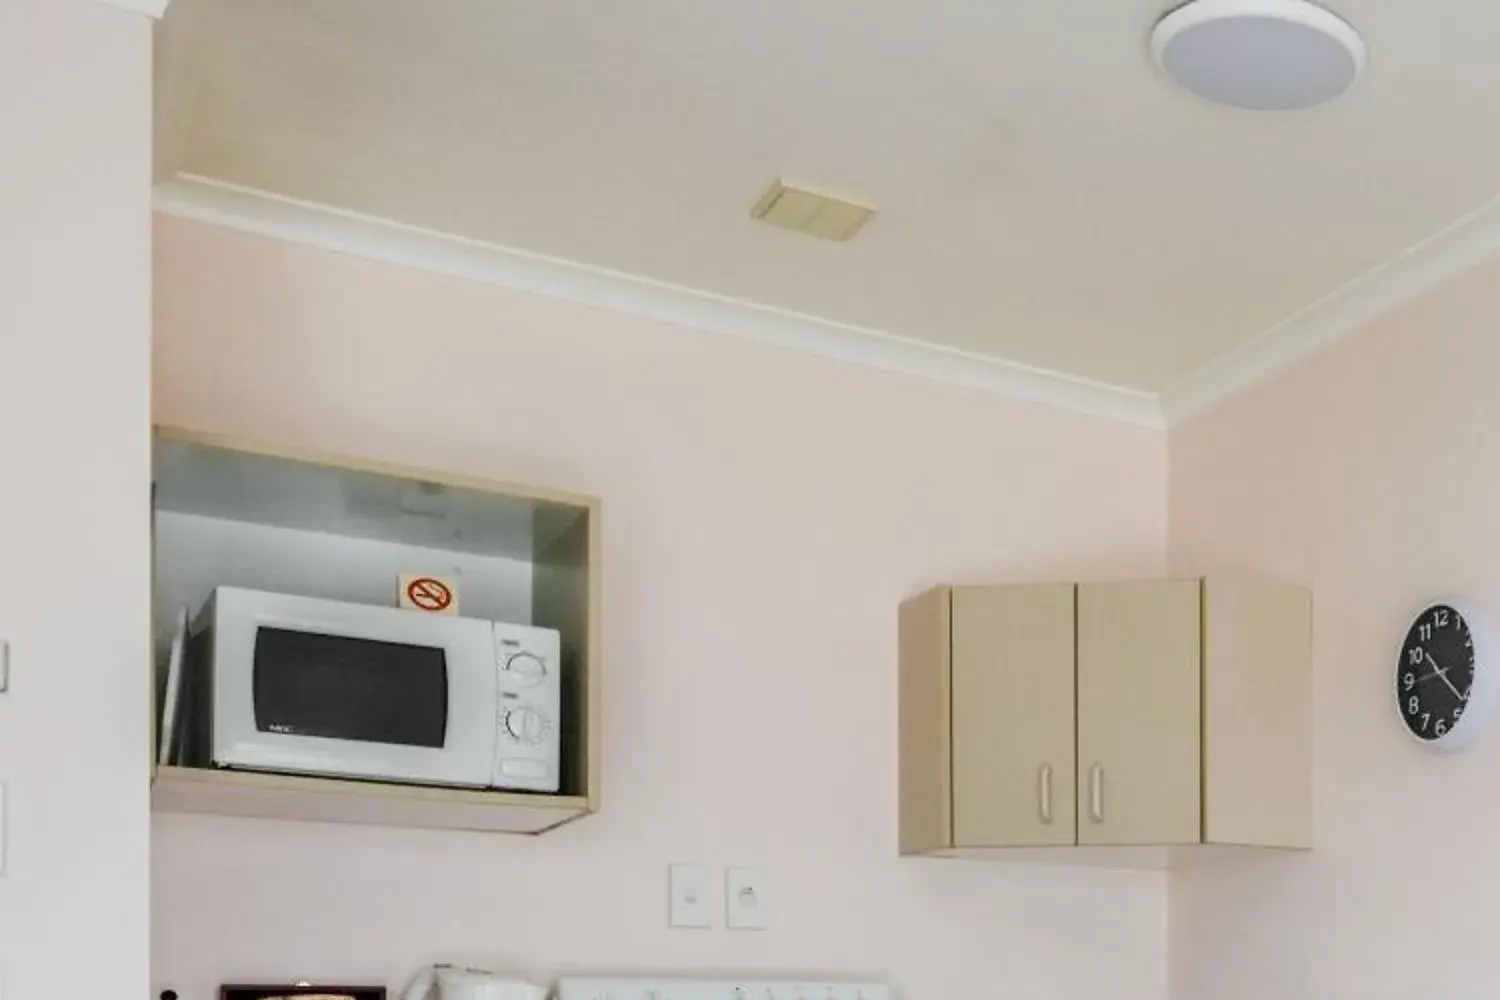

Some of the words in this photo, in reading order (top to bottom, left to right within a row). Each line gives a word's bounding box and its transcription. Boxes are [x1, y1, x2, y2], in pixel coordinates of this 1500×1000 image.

[1433, 609, 1449, 628] 12
[1455, 614, 1462, 630] 1
[1418, 623, 1431, 642] 11
[1408, 646, 1423, 666] 10
[1403, 672, 1415, 691] 9
[1408, 696, 1419, 715] 8
[1420, 712, 1431, 732] 7
[1435, 718, 1446, 738] 6
